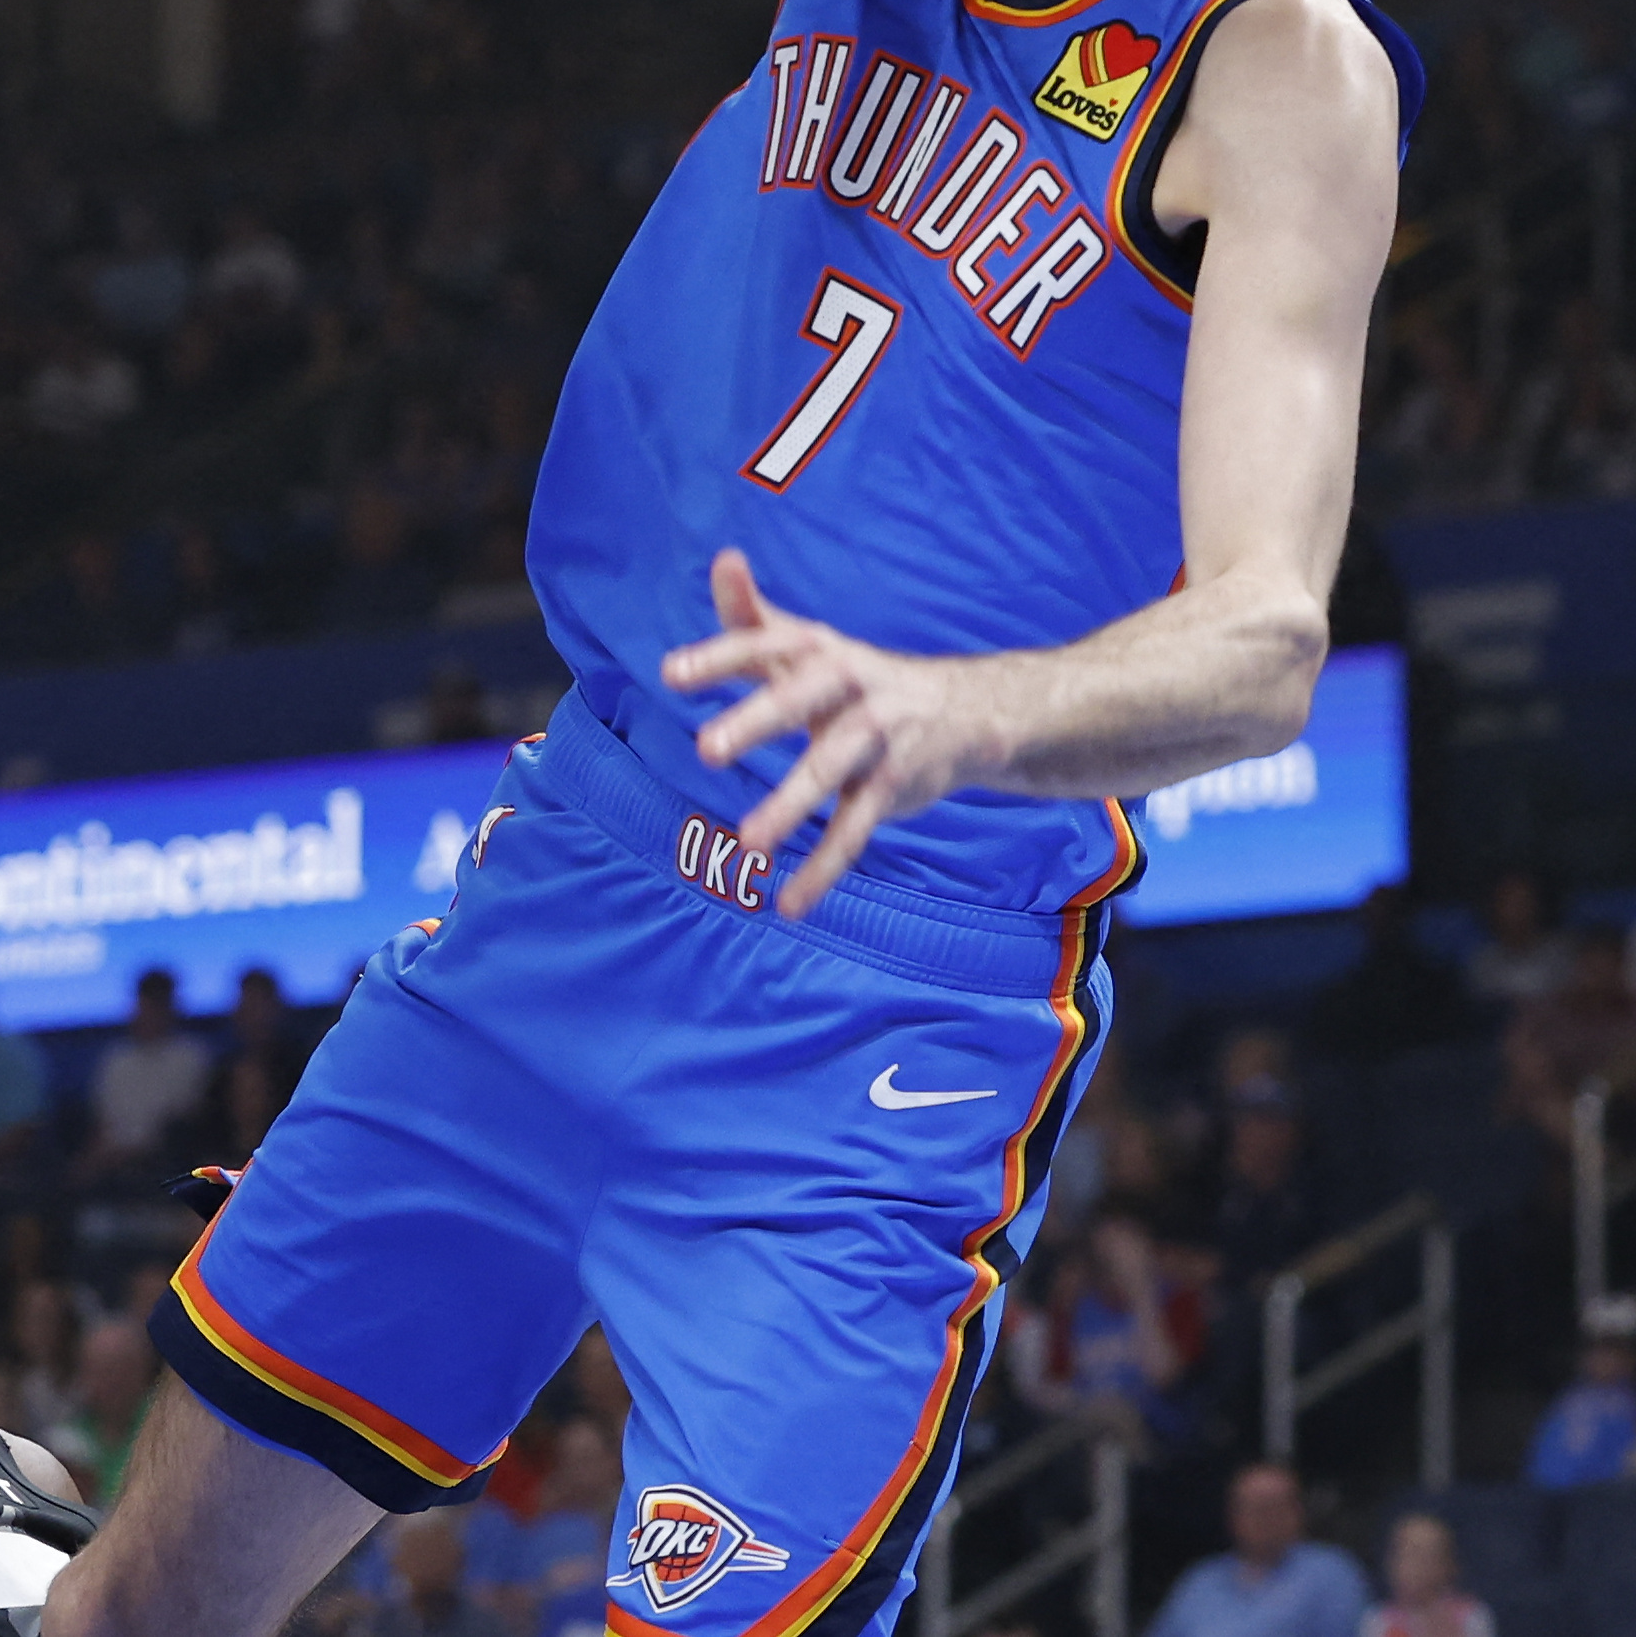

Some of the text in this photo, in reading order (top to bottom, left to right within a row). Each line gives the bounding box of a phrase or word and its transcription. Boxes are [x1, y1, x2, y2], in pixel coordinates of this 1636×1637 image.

[759, 33, 1112, 363] THUNDER
[738, 266, 904, 494] 7
[677, 815, 774, 912] OKC
[630, 1518, 717, 1568] OKC
